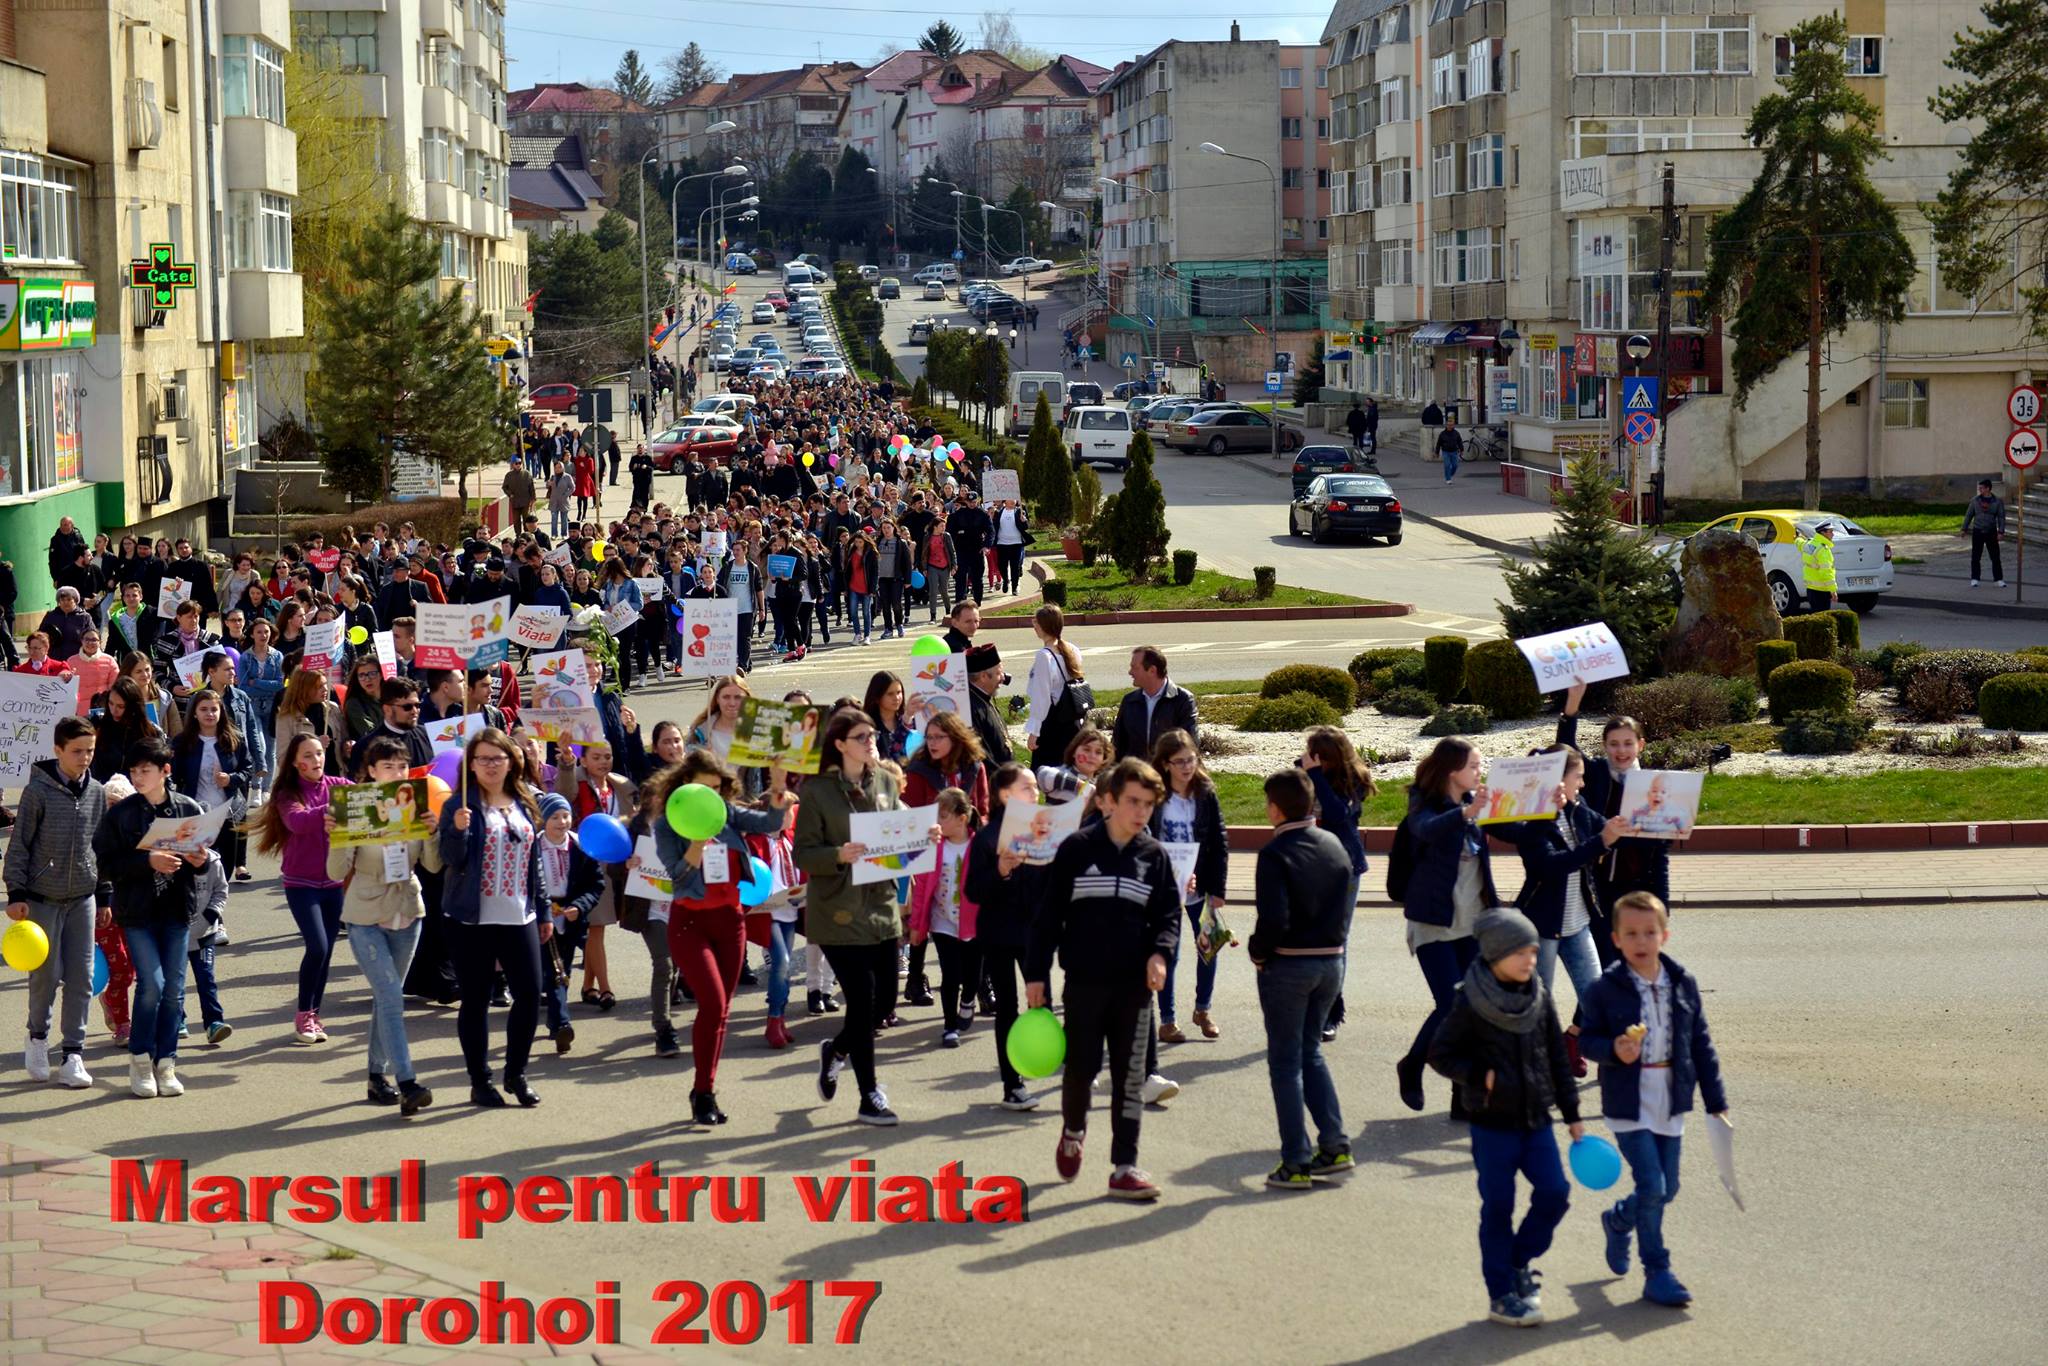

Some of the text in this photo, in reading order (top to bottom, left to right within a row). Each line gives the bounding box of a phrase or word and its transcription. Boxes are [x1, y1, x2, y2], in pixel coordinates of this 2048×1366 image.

[1563, 166, 1603, 200] VENEZIA
[1543, 652, 1616, 679] SUNT IUBIRE
